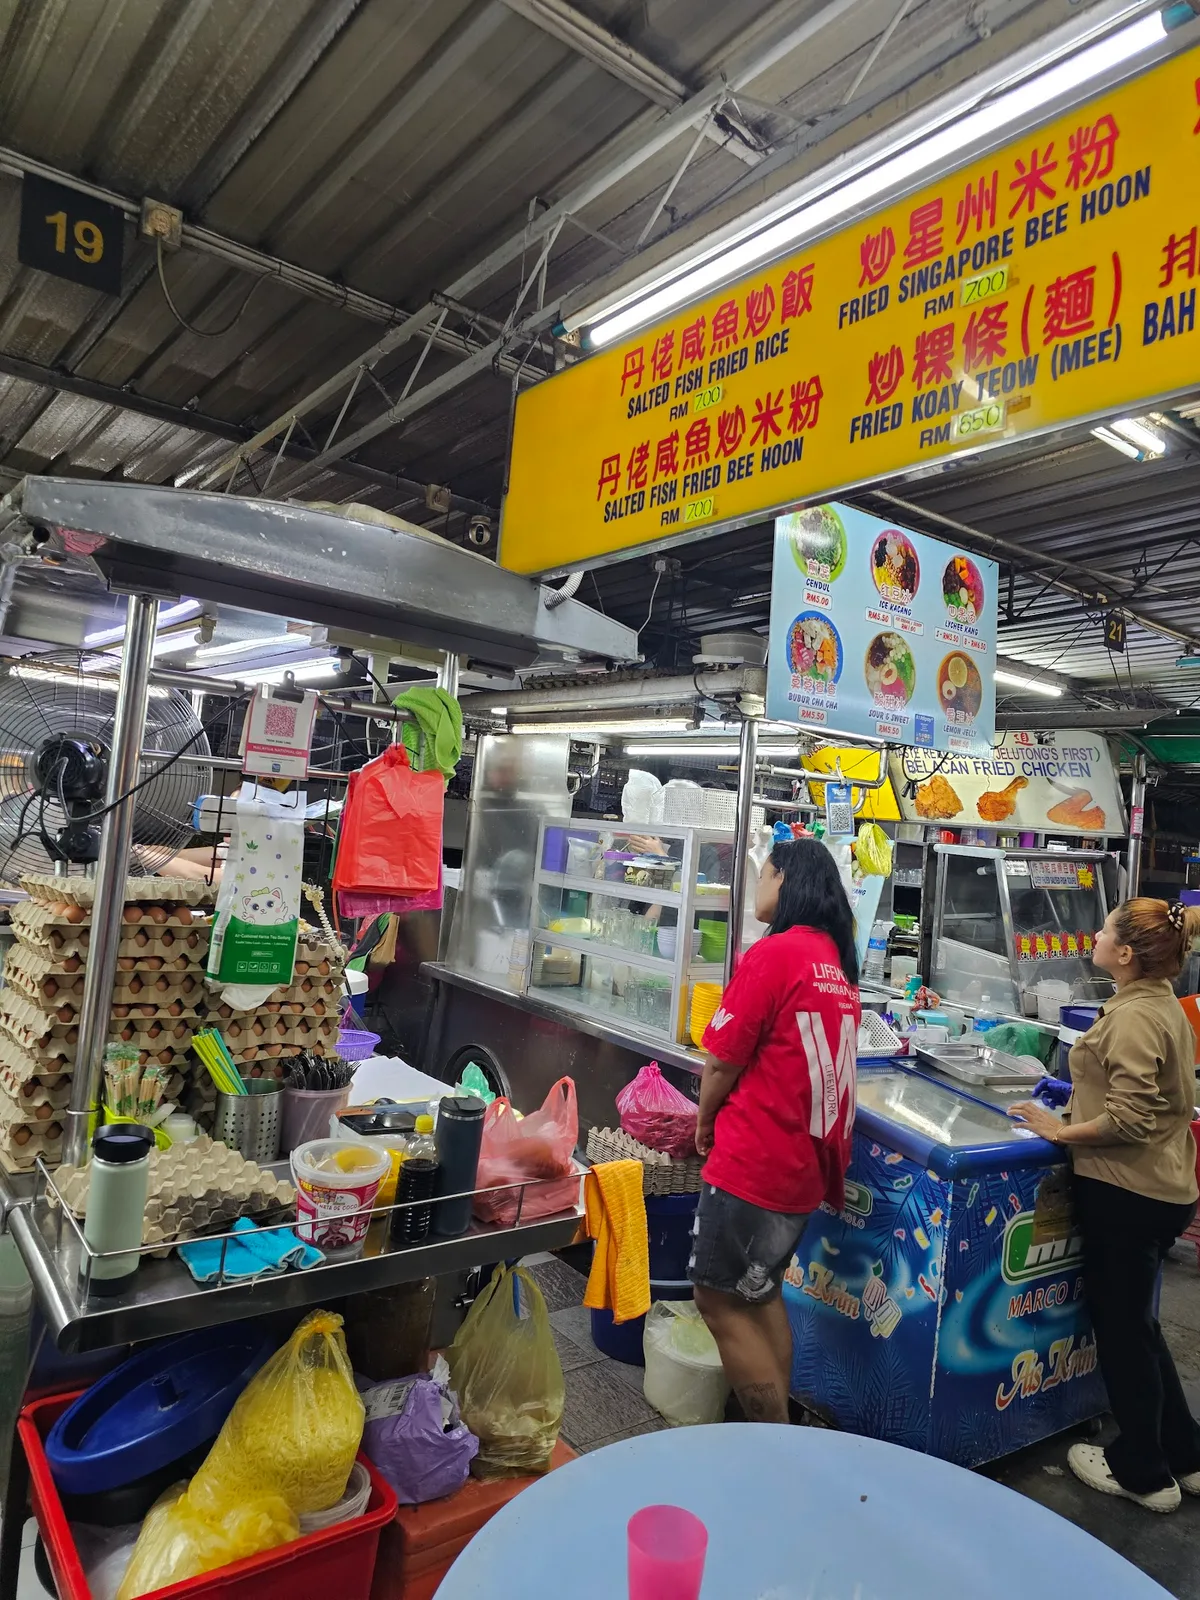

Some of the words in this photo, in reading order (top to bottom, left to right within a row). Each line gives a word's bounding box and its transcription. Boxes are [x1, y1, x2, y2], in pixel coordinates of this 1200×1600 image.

[858, 113, 1120, 288] 炒星州米粉
[45, 210, 104, 264] 19
[838, 284, 889, 329] FRIED
[898, 227, 1015, 303] SINGAPORE
[1025, 203, 1068, 249] BEE
[1080, 165, 1151, 225] HOON
[924, 292, 954, 319] RM
[1143, 288, 1197, 346] BAH
[628, 382, 670, 420] SALTED
[674, 366, 703, 398] FISH
[708, 347, 748, 384] FRIED
[755, 328, 790, 365] RICE
[850, 402, 903, 443] FRIED
[911, 380, 964, 424] KOAY
[976, 353, 1039, 402] TEOW
[1051, 323, 1122, 381] (MEE)
[670, 401, 688, 422] RM
[919, 423, 951, 449] RM
[604, 490, 645, 523] SALTED
[650, 478, 677, 508] FISH
[682, 464, 721, 497] FRIED
[726, 453, 755, 484] BEE
[761, 436, 804, 473] HOON
[660, 508, 680, 527] RM
[805, 578, 830, 592] CENDUL
[806, 593, 829, 606] RM5.00
[879, 600, 889, 610] ICE
[890, 603, 912, 616] KACANG
[868, 611, 889, 622] RM5.50
[945, 620, 964, 632] LYCHEE
[964, 625, 978, 636] KANG
[1109, 620, 1122, 642] 21
[788, 692, 811, 705] BUBUR
[811, 697, 824, 707] CHA
[826, 700, 838, 710] CHA
[801, 710, 824, 720] RM5.50
[868, 709, 884, 720] SOUR
[890, 712, 910, 725] SWEET
[878, 724, 900, 735] RM5.50
[943, 724, 961, 735] LEMON
[962, 728, 977, 738] JELLY
[1062, 747, 1100, 762] FIRST)
[906, 759, 970, 775] BELACAN
[974, 761, 1015, 776] FRIED
[1021, 762, 1091, 778] CHICKEN
[1020, 952, 1032, 960] SALE
[1036, 951, 1047, 960] SALE
[1050, 950, 1061, 958] SALE
[1067, 949, 1078, 958] SALE
[825, 1063, 838, 1117] LIFEWORK
[342, 1203, 357, 1211] COCO
[840, 1210, 866, 1230] POLO
[803, 1262, 860, 1319] Krim
[1007, 1280, 1068, 1321] MARCO
